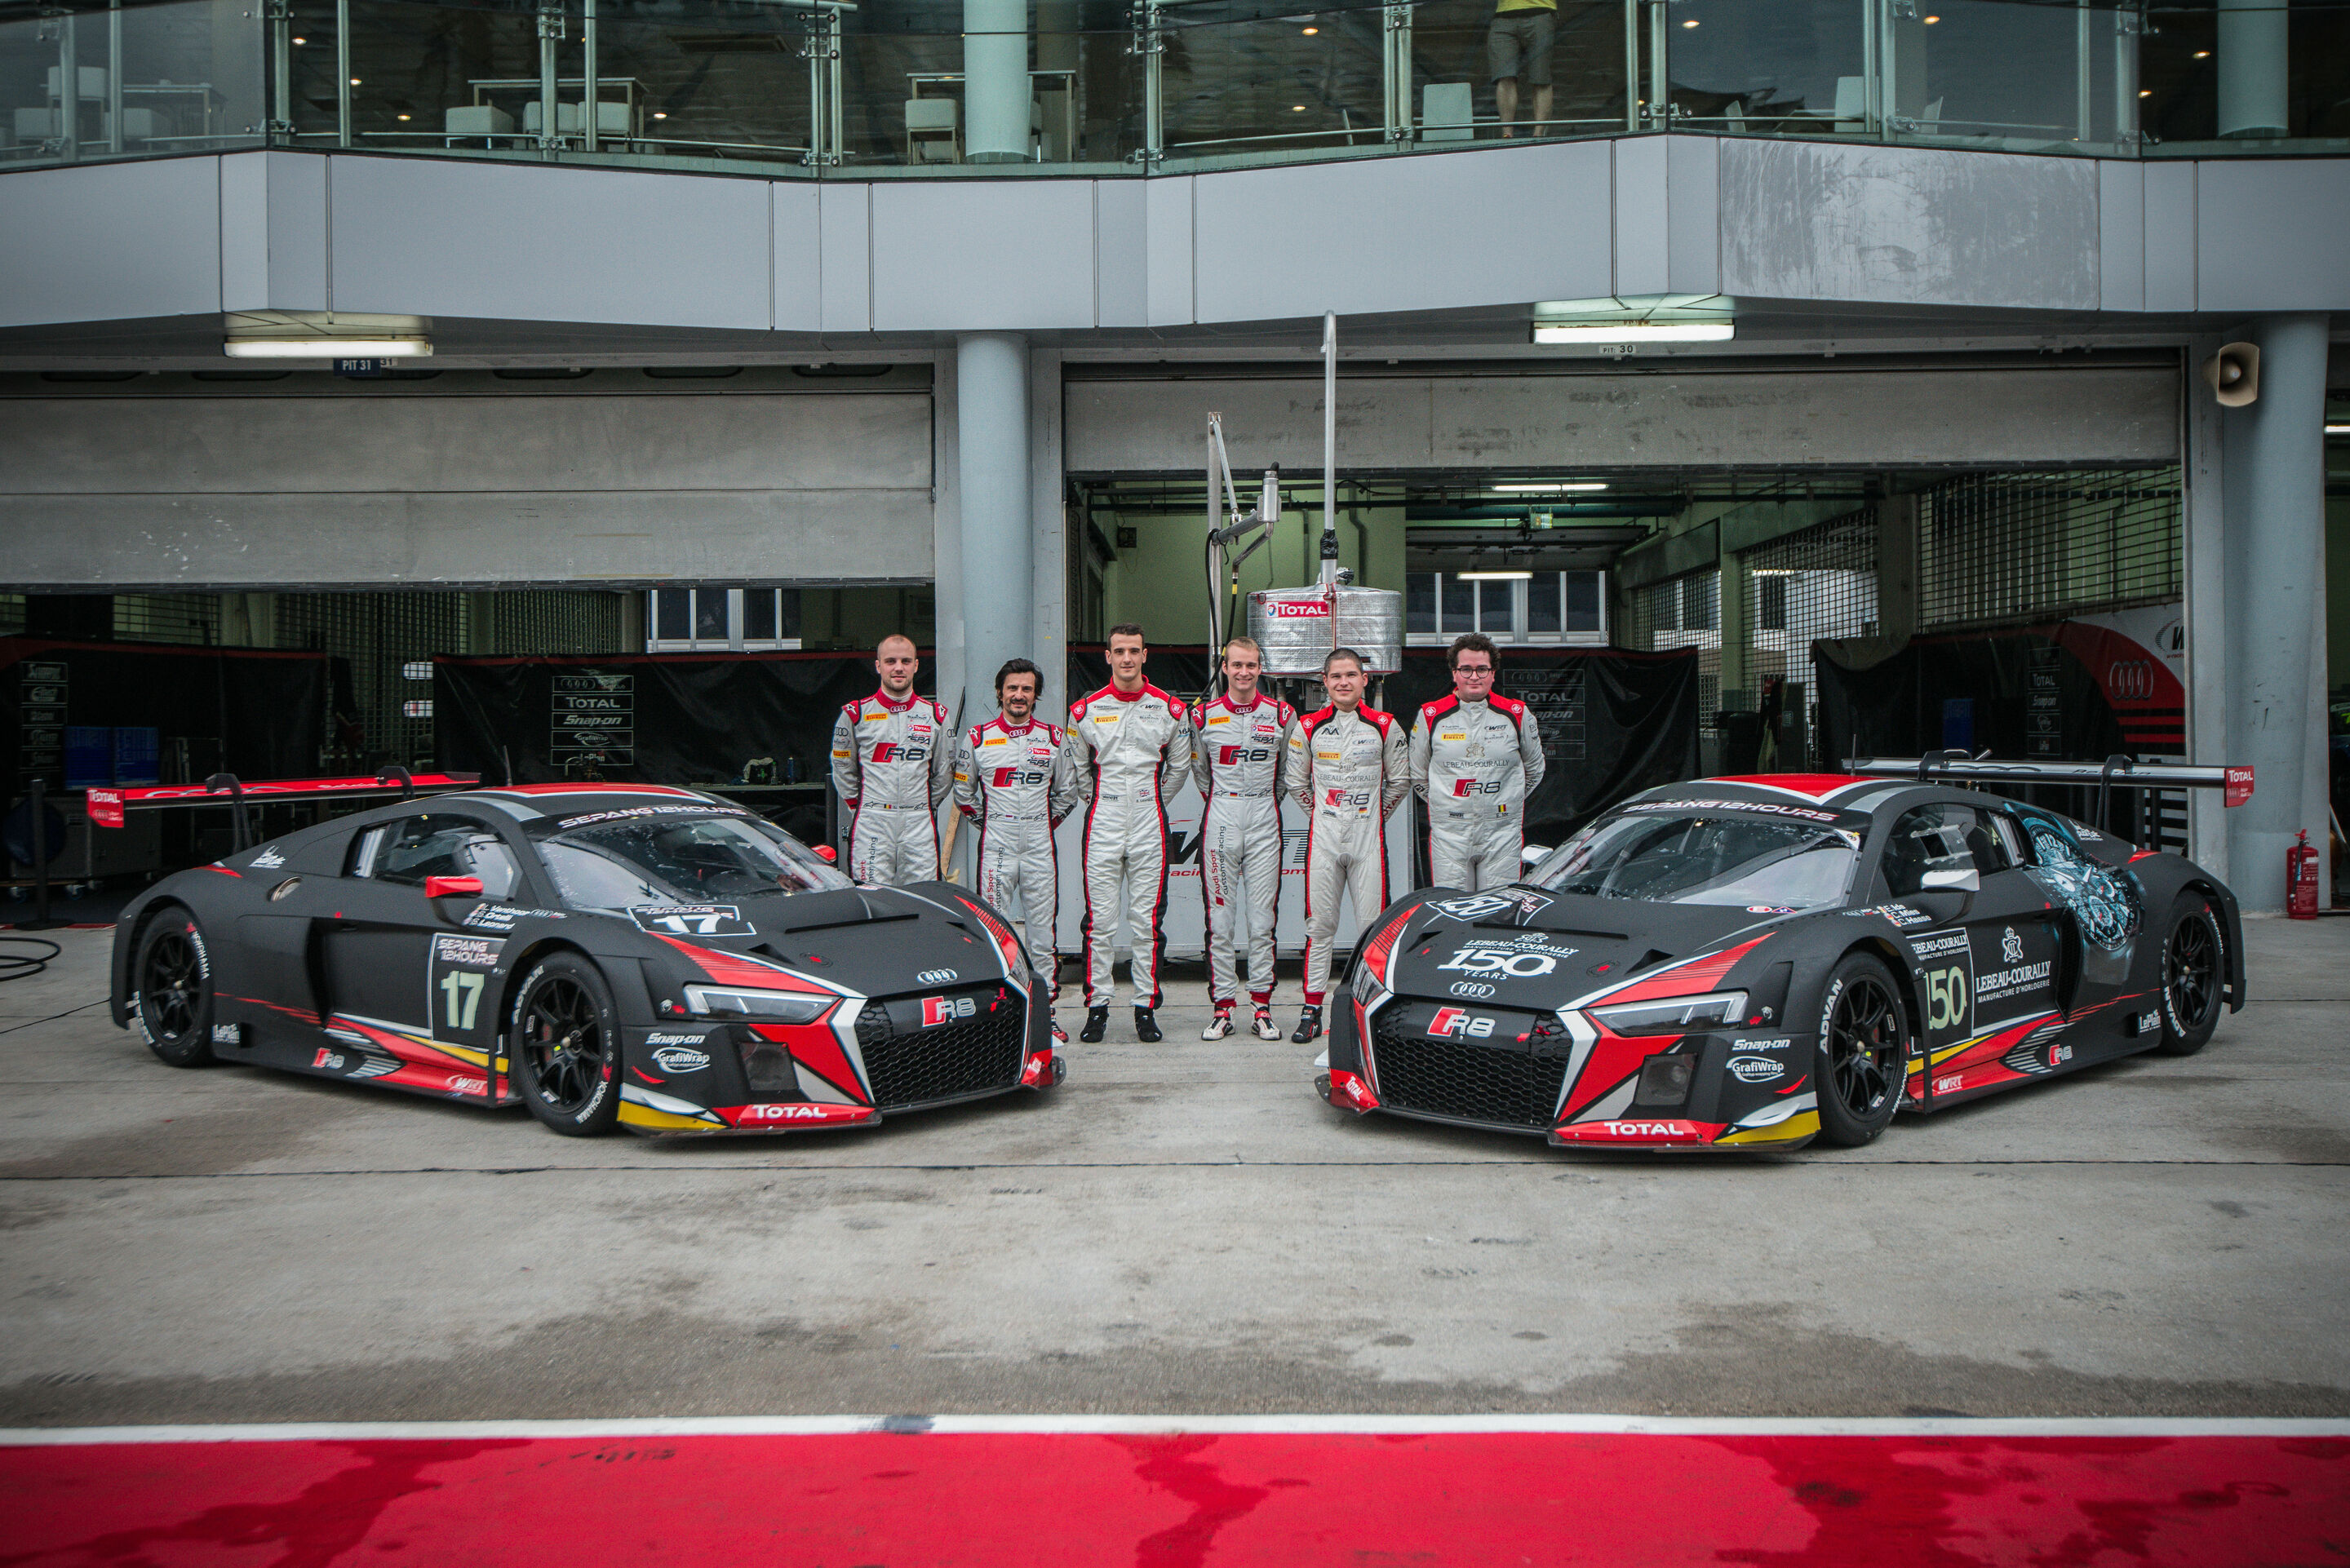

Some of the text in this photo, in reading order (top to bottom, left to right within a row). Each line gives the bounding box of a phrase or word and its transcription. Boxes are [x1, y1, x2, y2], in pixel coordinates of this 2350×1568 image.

[1620, 345, 1634, 353] 30
[342, 359, 371, 371] PIT 31
[1279, 604, 1328, 616] TOTAL
[2032, 673, 2056, 686] TOTAL
[565, 697, 621, 708] TOTAL
[1517, 690, 1572, 702] TOTAL
[563, 715, 623, 728] Snap-on
[884, 747, 926, 761] R8
[1229, 749, 1270, 763] R8
[1443, 760, 1510, 768] LEBEAU-COURALLY
[1004, 771, 1044, 785] R8
[1318, 773, 1377, 782] LEBEAU-COURALLY
[2228, 769, 2253, 782] TOTAL
[1464, 781, 1501, 795] R8
[87, 790, 121, 803] TOTAL
[1334, 794, 1370, 805] R8
[995, 847, 1005, 873] racing
[1218, 826, 1229, 896] customer racing
[1213, 874, 1222, 895] Audi
[653, 915, 721, 933] 17
[437, 938, 490, 952] SEPANG
[1465, 939, 1580, 956] LEBEAU-COURALLY
[441, 950, 499, 965] 12HOURS
[1515, 948, 1571, 959] D'HORLOGERIE
[1437, 949, 1557, 977] 150
[1464, 970, 1510, 980] YEARS
[1975, 960, 2051, 993] LEBEAU-COURALLY
[1978, 979, 2051, 1003] MANUFACTURE D'HORLOGERIE
[441, 970, 485, 1030] 17
[936, 998, 977, 1021] R8
[1820, 979, 1843, 1054] ADVAN
[1444, 1014, 1496, 1038] R8
[645, 1032, 706, 1046] Snap-on
[1731, 1039, 1791, 1052] Snap-on
[321, 1052, 344, 1070] R8
[658, 1052, 710, 1065] GrafiWrap
[2054, 1045, 2073, 1064] R8
[1731, 1061, 1785, 1073] GrafiWrap
[456, 1077, 488, 1091] WRT
[1346, 1076, 1363, 1101] TOTAL
[1938, 1075, 1963, 1091] WRT
[752, 1105, 828, 1118] TOTAL
[1604, 1122, 1684, 1136] TOTAL
